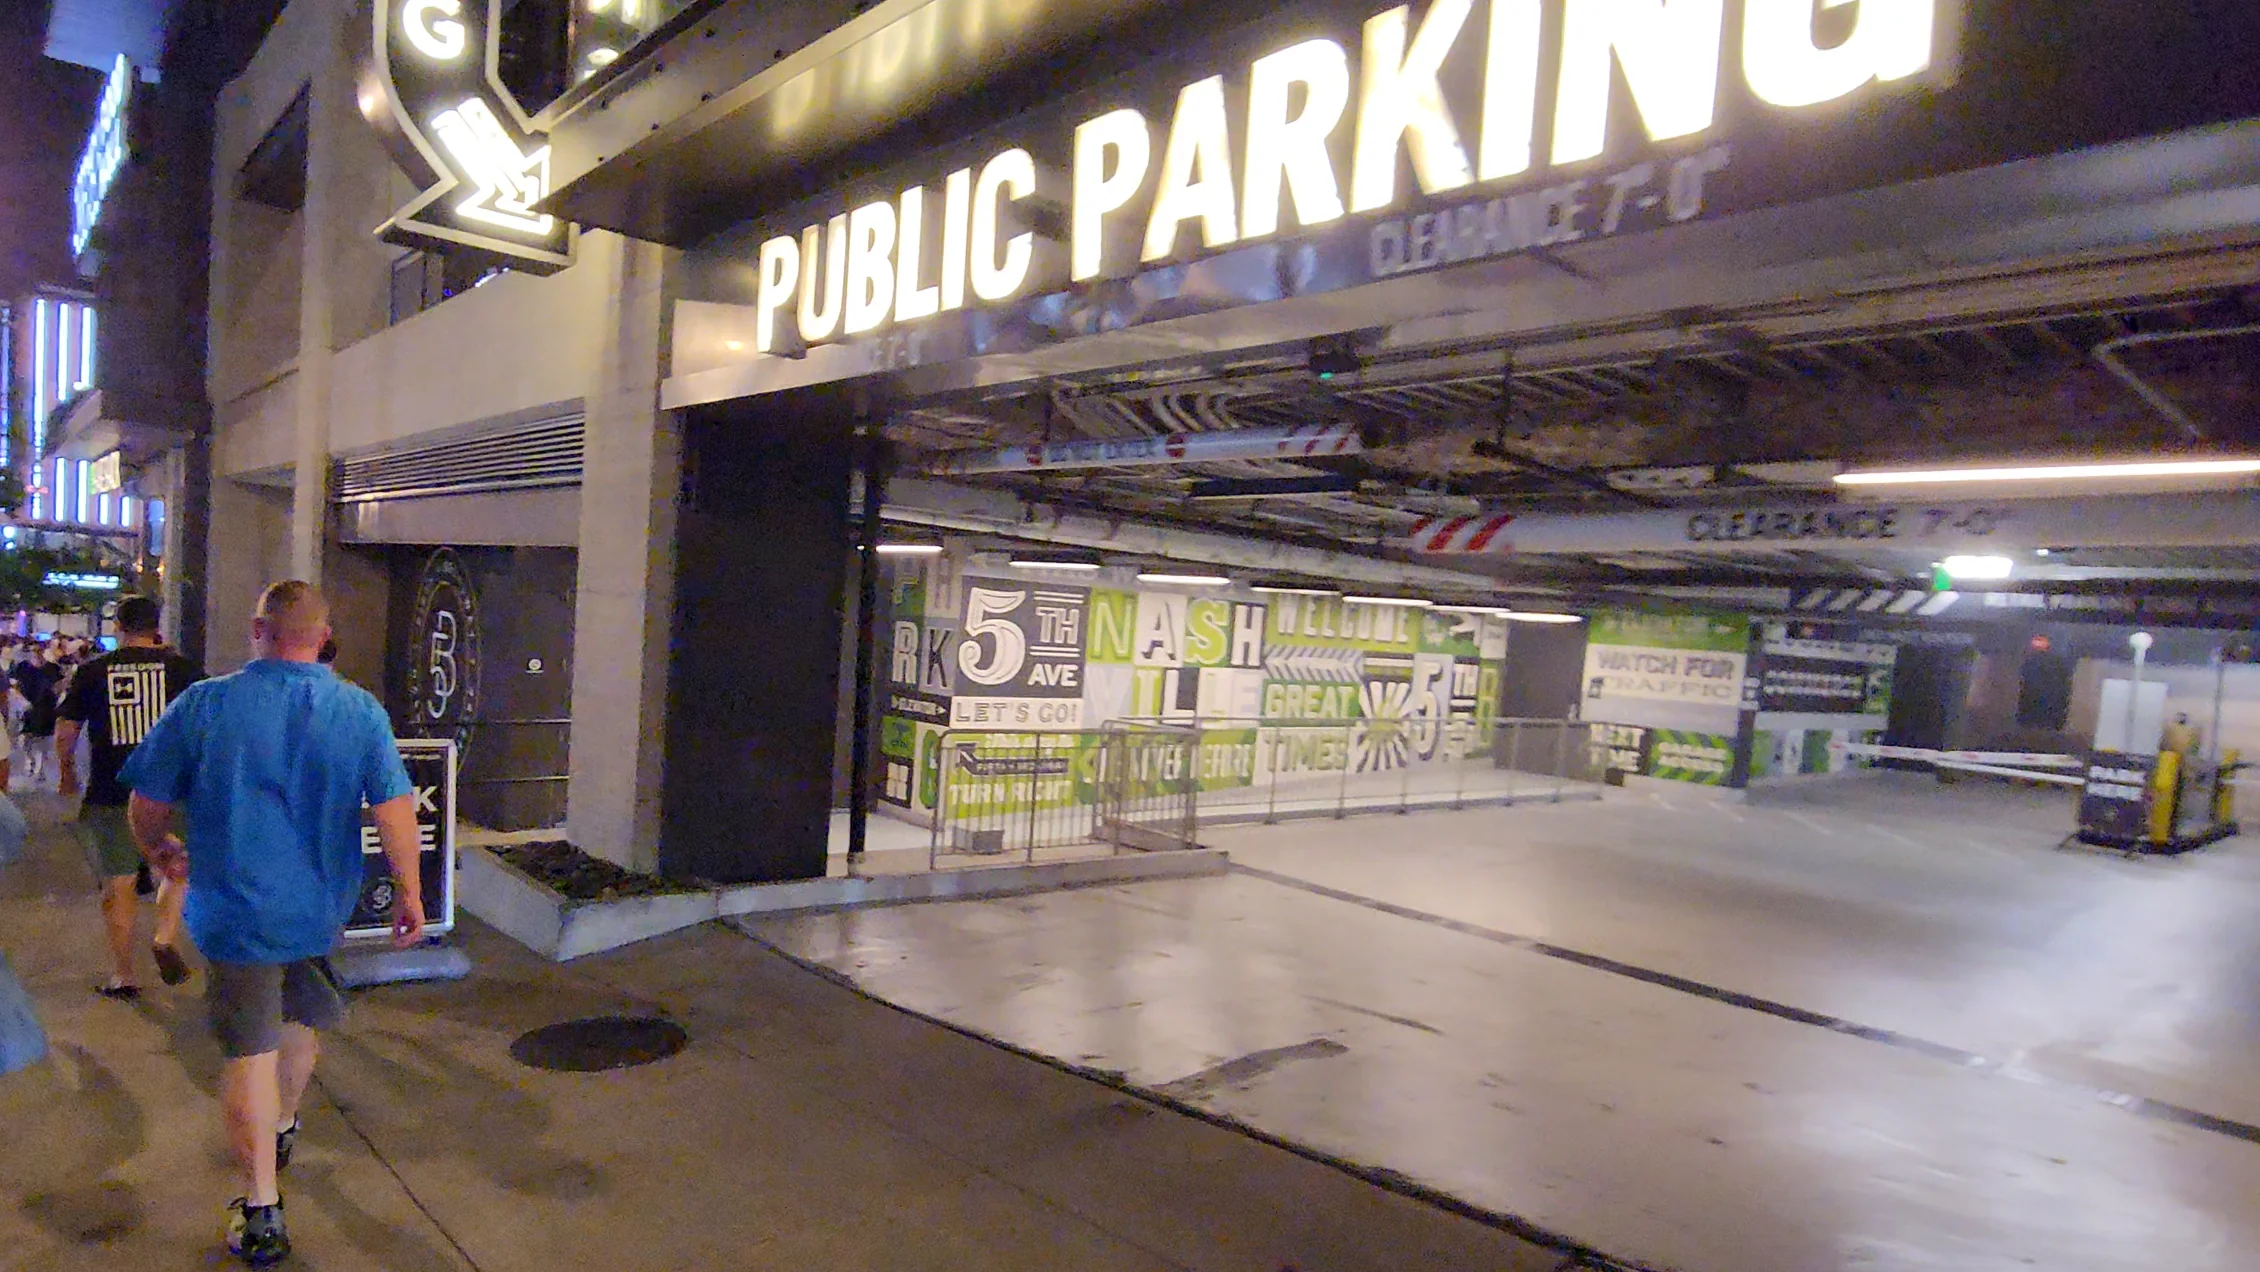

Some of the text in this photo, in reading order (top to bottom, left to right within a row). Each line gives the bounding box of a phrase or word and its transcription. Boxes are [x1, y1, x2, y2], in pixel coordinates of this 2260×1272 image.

[757, 147, 1036, 354] PUBLIC
[958, 586, 1081, 686] 5 TH
[1091, 595, 1264, 666] NASH
[1028, 663, 1079, 687] AVE
[1597, 649, 1734, 680] WATCH FOR
[1265, 684, 1355, 718] GREAT
[1602, 676, 1733, 699] TRAFFIC
[956, 700, 1030, 723] LET'S
[1038, 702, 1077, 723] GO!
[1262, 732, 1347, 773] TIMES
[949, 780, 1072, 805] TURN RIGHT
